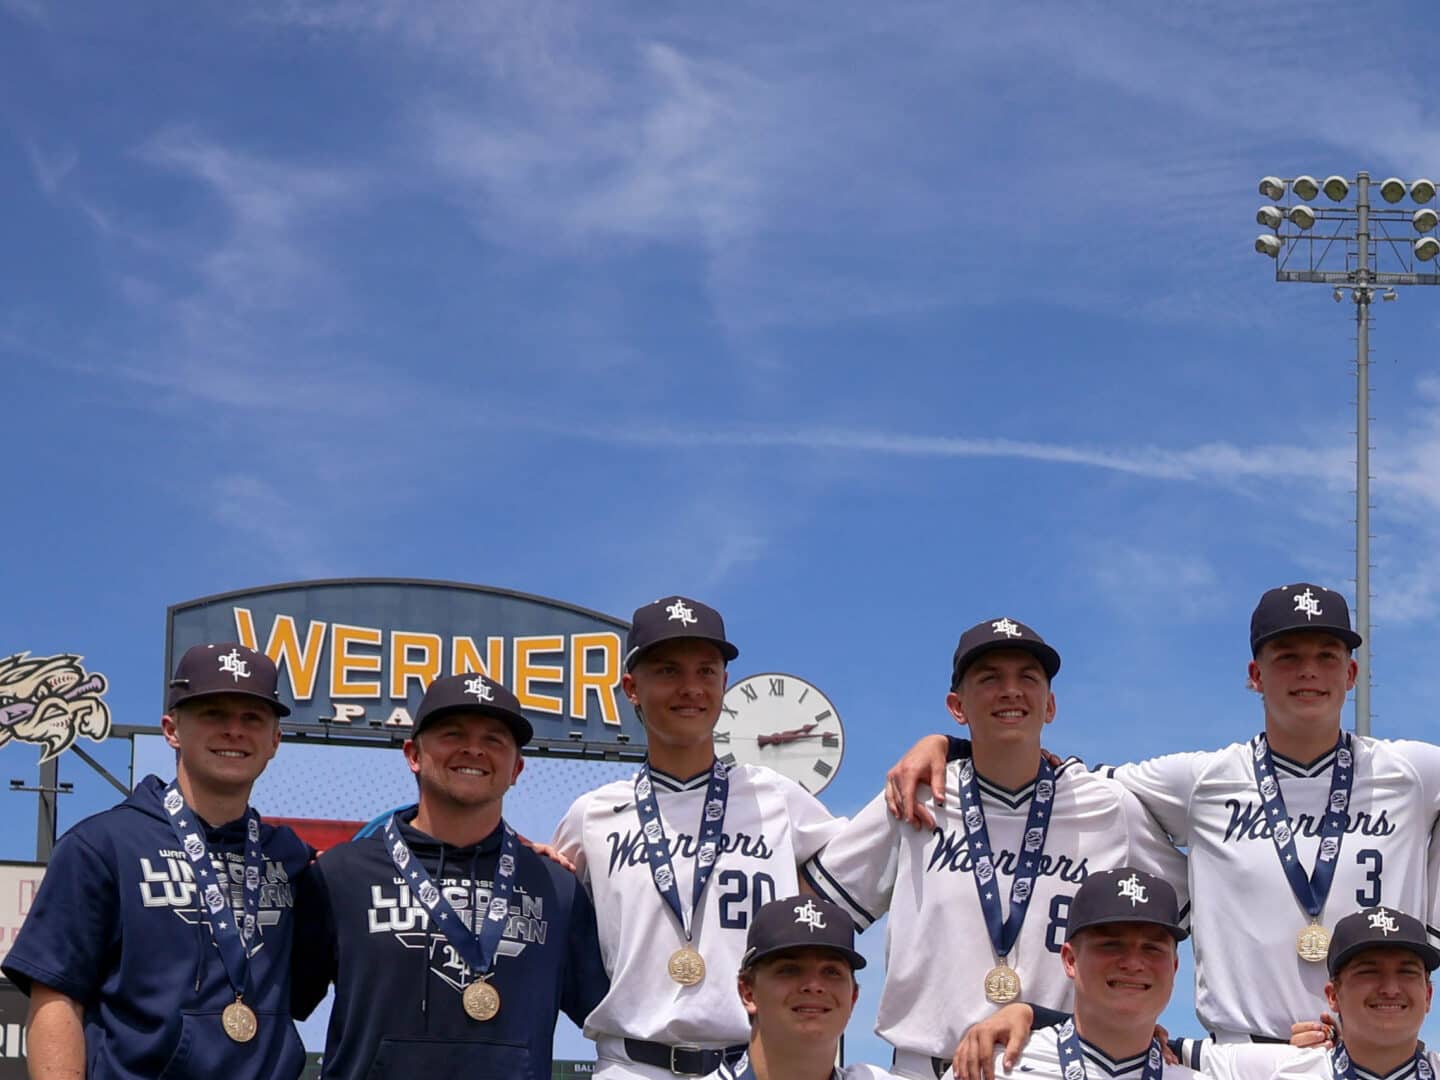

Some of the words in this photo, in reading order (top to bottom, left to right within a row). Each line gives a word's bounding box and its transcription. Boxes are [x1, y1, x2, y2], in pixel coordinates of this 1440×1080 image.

[232, 607, 622, 725] WERNER
[1222, 798, 1396, 843] Warrs
[606, 829, 773, 879] Warors
[926, 826, 1089, 884] Warors
[1355, 848, 1383, 908] 3
[718, 869, 776, 930] 20
